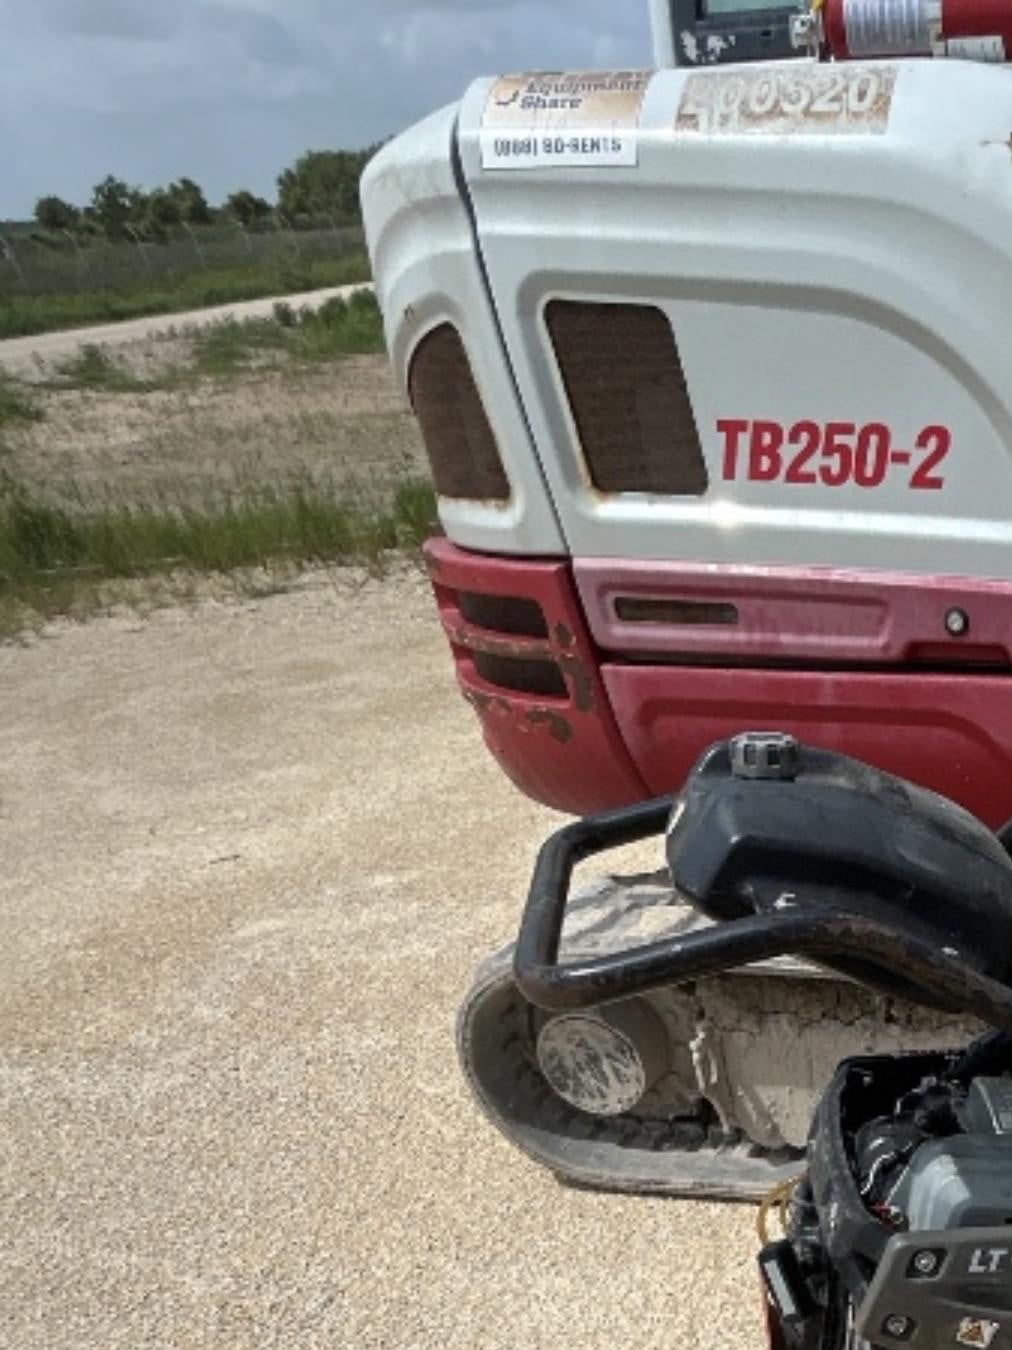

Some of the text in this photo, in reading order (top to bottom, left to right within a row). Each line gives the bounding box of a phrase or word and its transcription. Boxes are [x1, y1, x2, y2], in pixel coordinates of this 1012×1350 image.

[520, 96, 583, 109] Share
[716, 419, 951, 490] TB250-2
[968, 1248, 1009, 1273] LT
